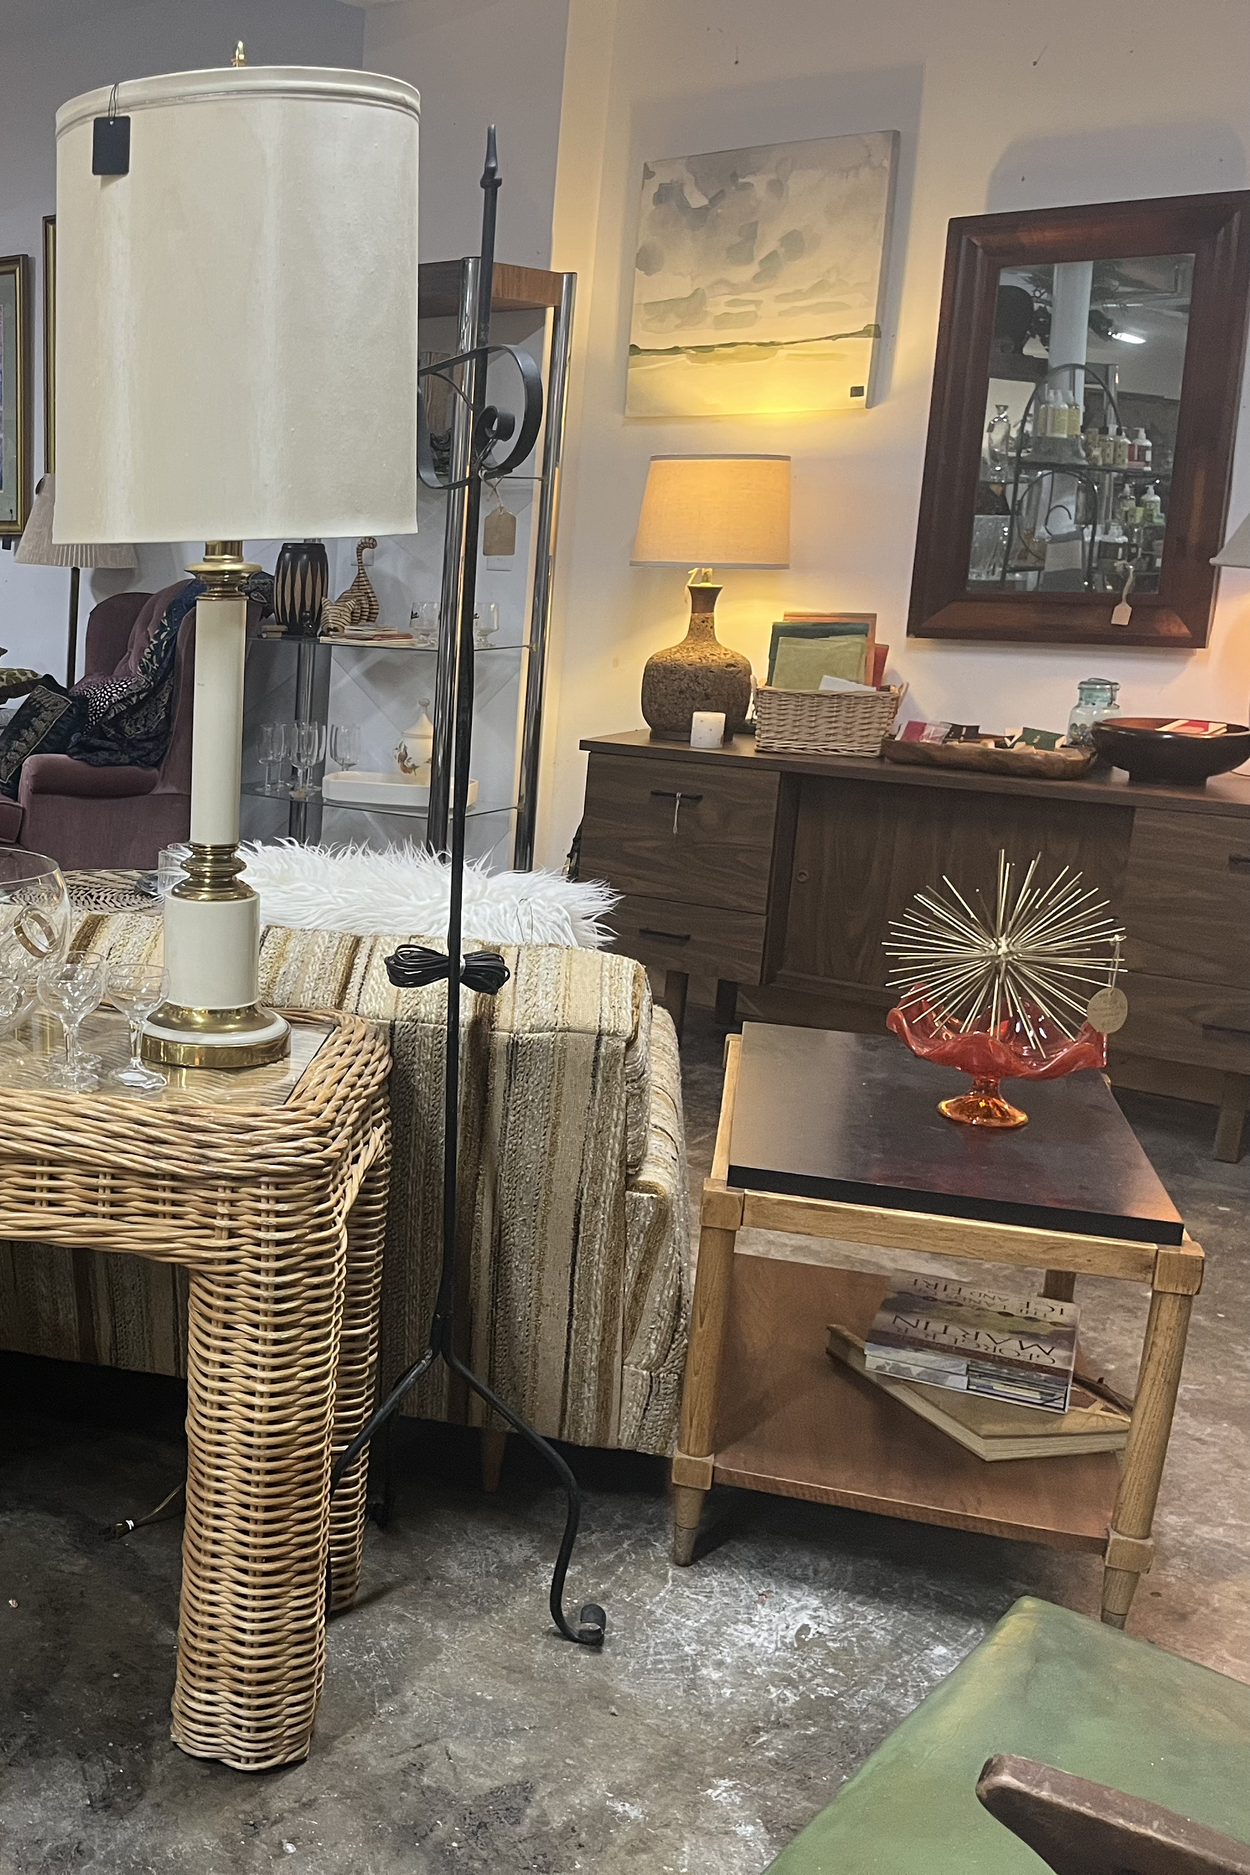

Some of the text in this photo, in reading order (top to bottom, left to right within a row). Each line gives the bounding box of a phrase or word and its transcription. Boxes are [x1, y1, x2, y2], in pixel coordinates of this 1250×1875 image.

[907, 1278, 1065, 1316] ICE AND FIRE
[892, 1314, 1056, 1356] MARTIN
[953, 1337, 1056, 1365] GEORGE
